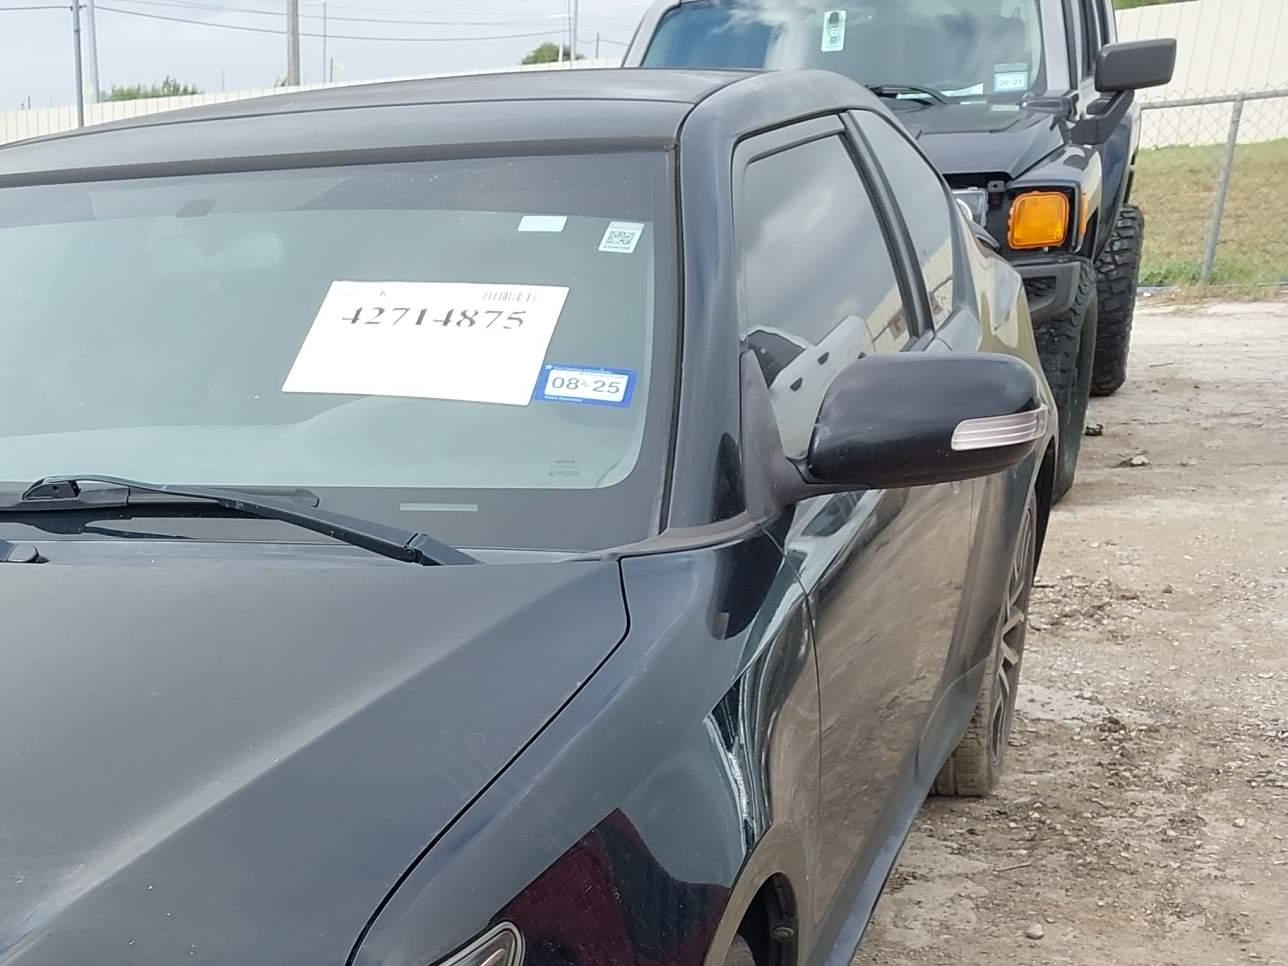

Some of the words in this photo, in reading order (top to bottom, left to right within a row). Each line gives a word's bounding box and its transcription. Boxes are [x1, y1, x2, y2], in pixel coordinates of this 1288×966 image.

[341, 305, 528, 330] 42714875
[552, 376, 580, 390] 08
[592, 379, 621, 394] 25
